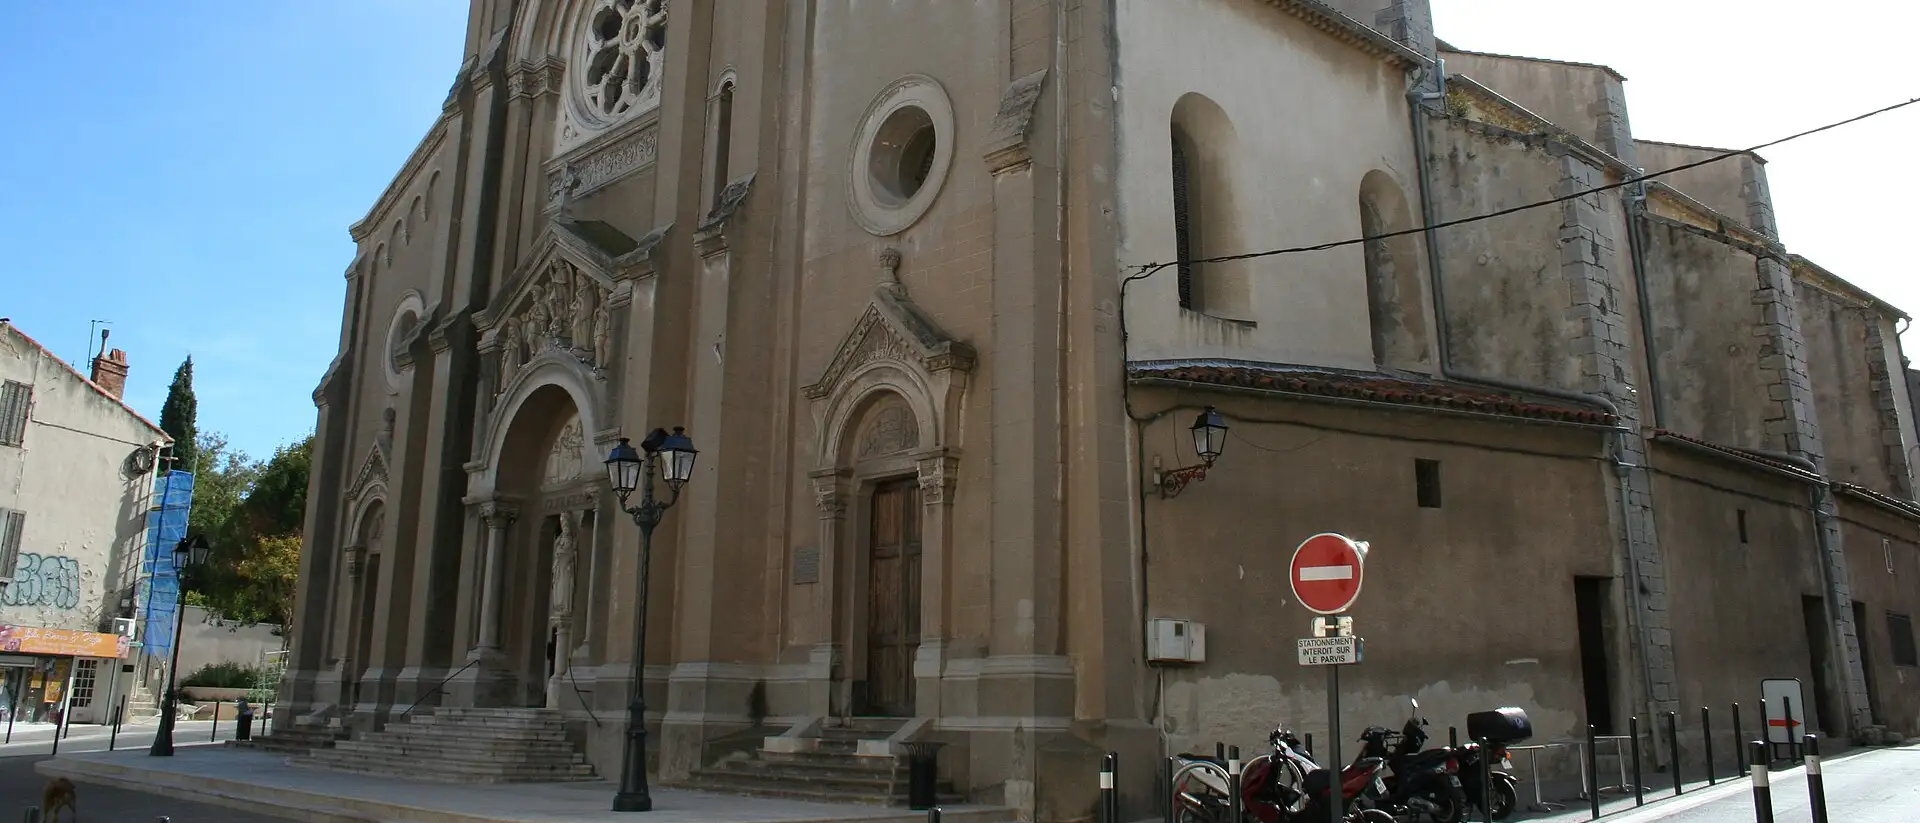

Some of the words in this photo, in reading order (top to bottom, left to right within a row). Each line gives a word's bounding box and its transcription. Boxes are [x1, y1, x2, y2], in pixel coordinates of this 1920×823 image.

[1299, 638, 1353, 647] STATIONNEMENT
[1303, 647, 1332, 655] INTERDIT
[1337, 646, 1350, 654] SUR
[1321, 655, 1345, 663] PARVIS
